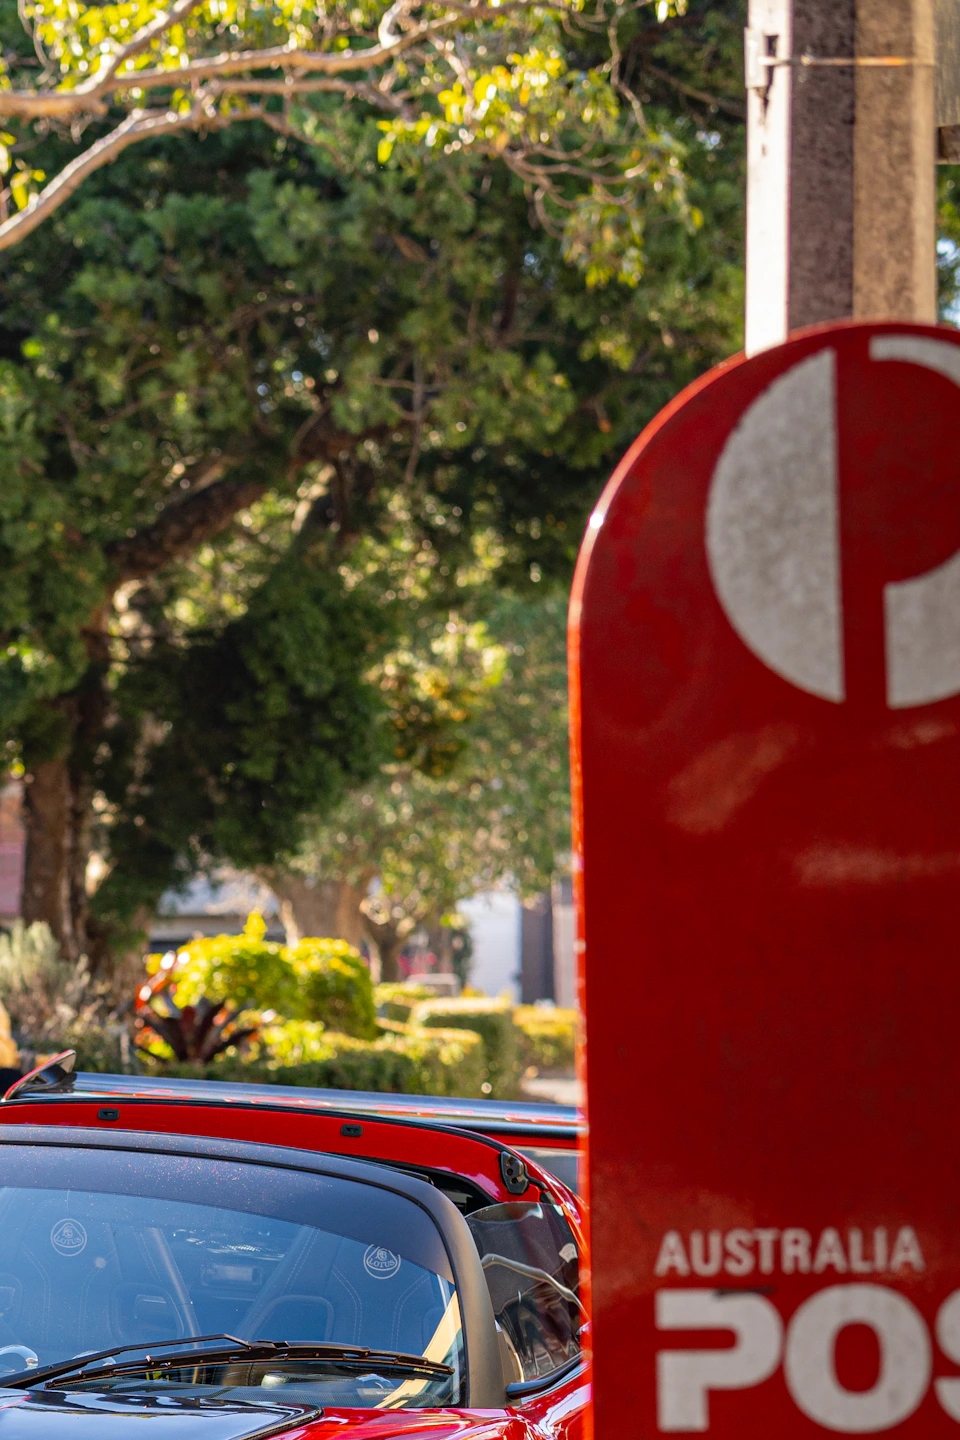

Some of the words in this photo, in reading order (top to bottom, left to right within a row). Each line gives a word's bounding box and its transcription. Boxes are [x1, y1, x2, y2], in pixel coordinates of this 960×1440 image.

[55, 1236, 82, 1246] LOTUS
[655, 1226, 925, 1276] AUSTRALIA
[369, 1258, 395, 1268] LOTUS
[655, 1282, 960, 1433] PO
